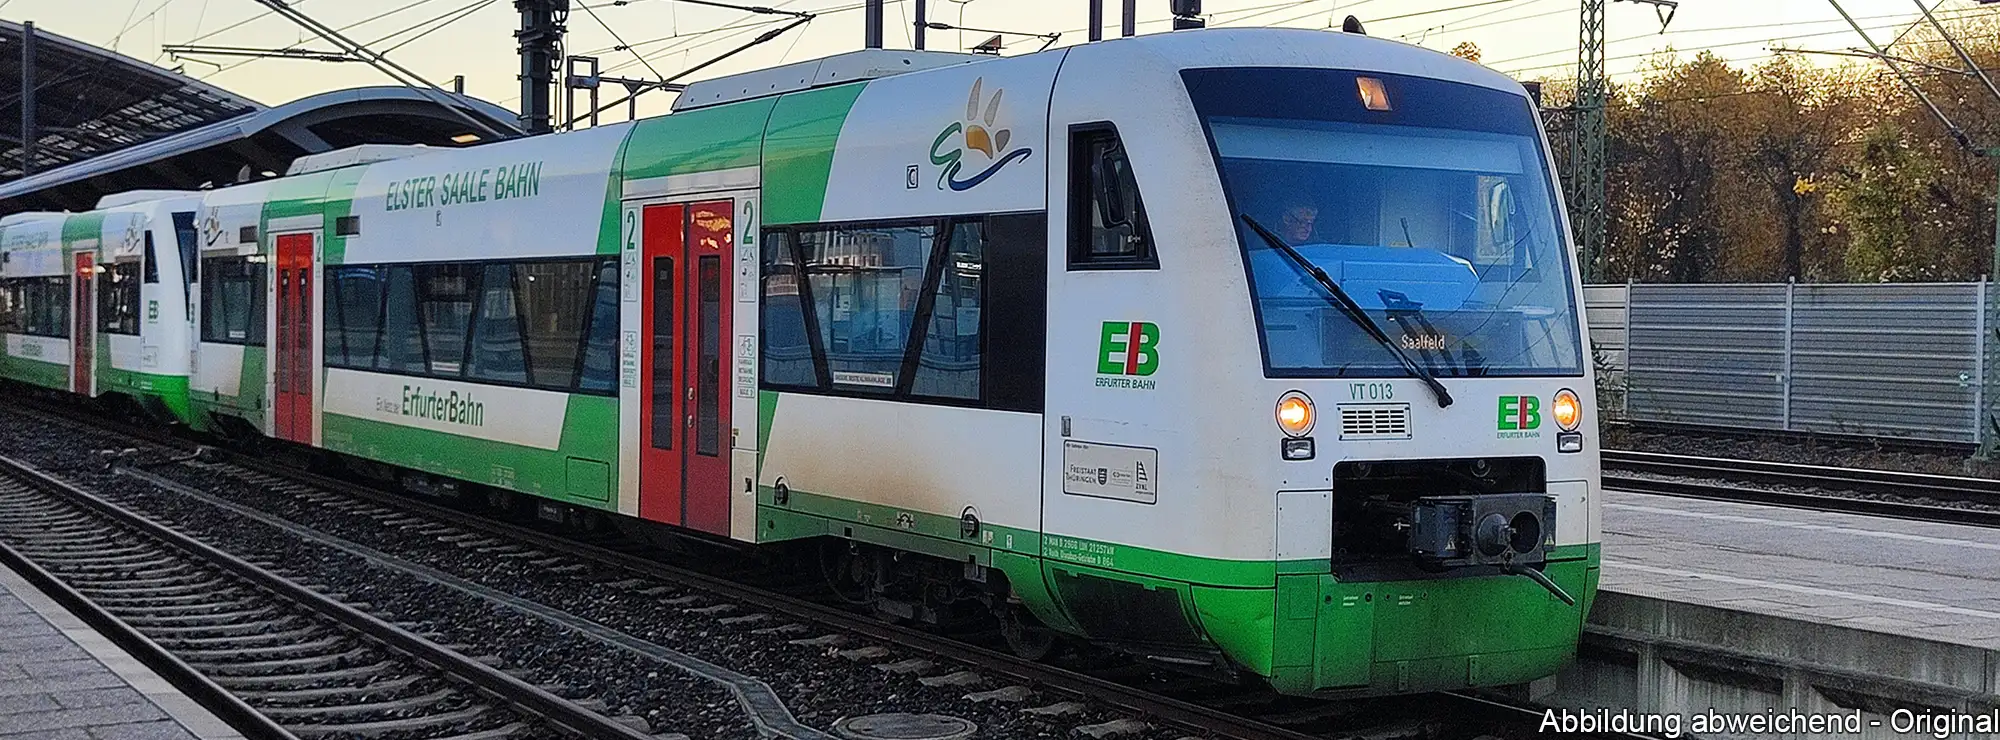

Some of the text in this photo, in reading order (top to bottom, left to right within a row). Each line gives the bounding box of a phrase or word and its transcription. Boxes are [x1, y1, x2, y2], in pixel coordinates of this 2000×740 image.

[386, 161, 543, 211] ELSTER SAALE BAHN
[627, 210, 635, 250] 2
[743, 200, 753, 244] 2
[1401, 334, 1445, 350] Saalfeld
[1095, 377, 1156, 390] ERFURTER BAHN
[1350, 383, 1393, 400] VT 013
[402, 385, 484, 427] ErfurterBahn
